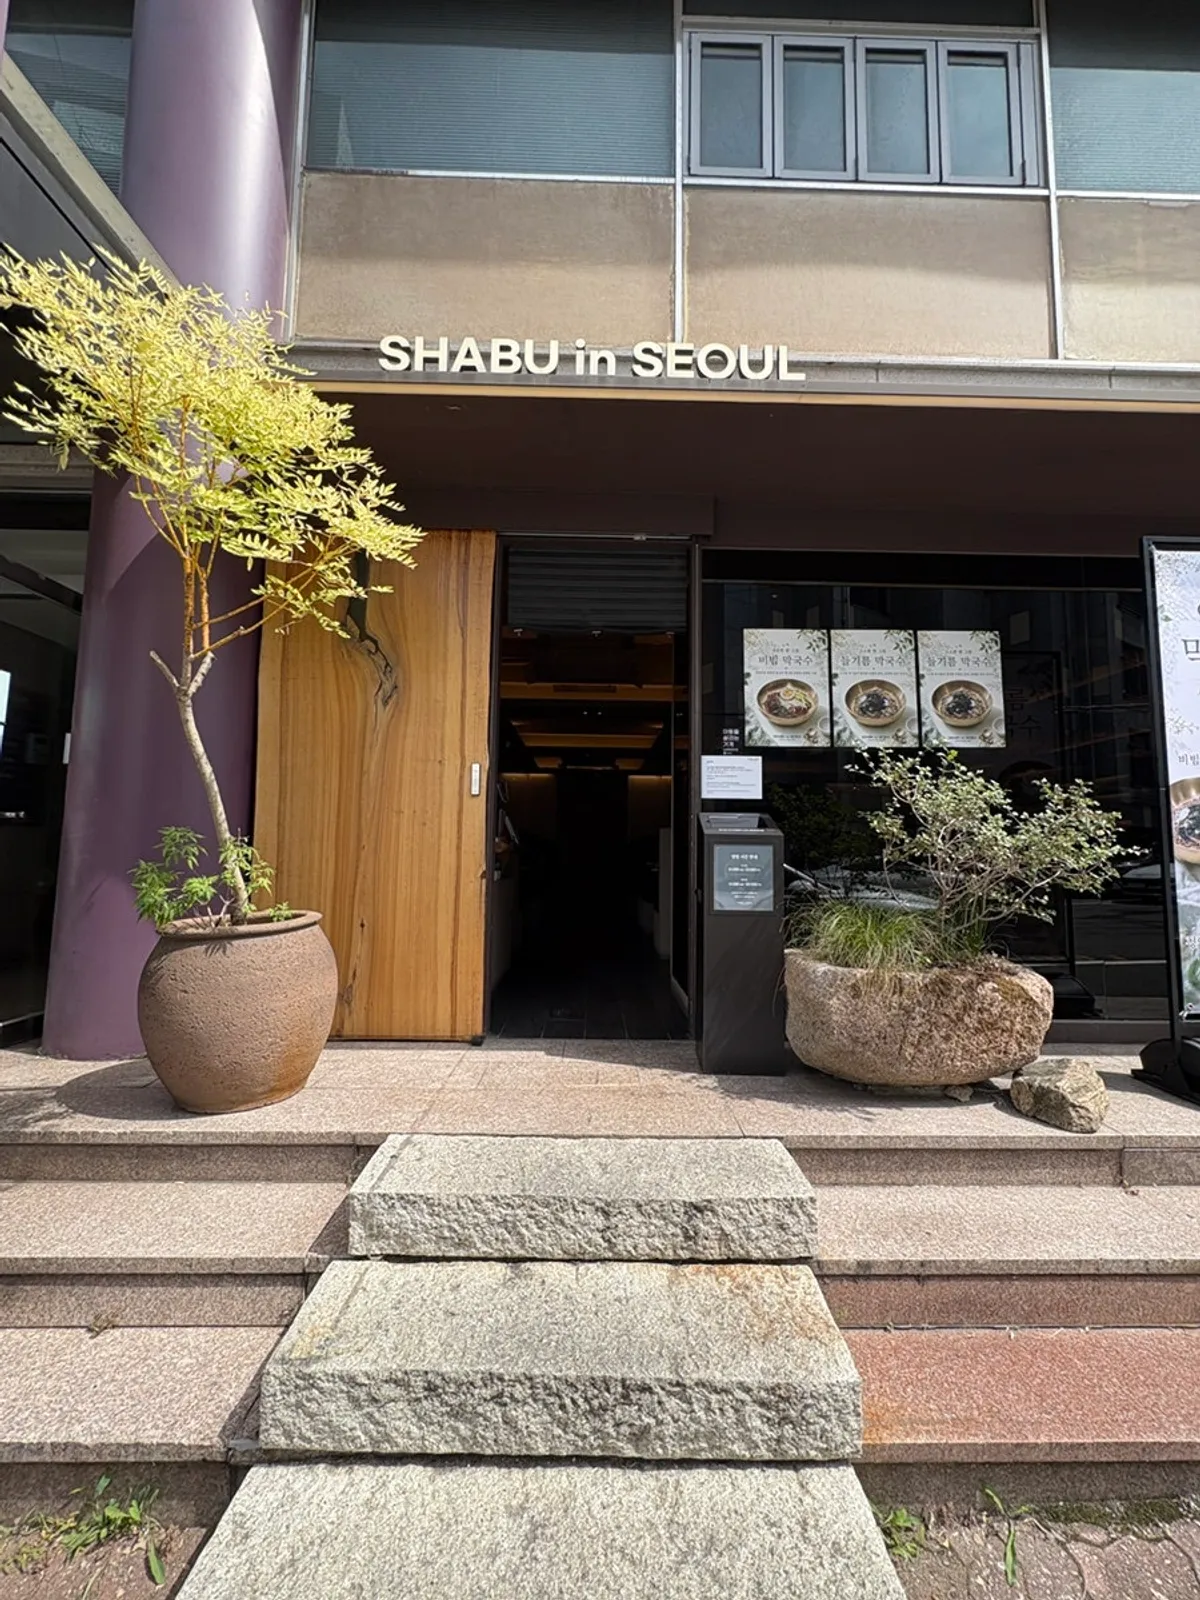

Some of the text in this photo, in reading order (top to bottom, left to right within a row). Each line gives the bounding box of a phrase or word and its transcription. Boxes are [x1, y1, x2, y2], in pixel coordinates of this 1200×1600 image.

[378, 334, 807, 382] SHABU in SEOUL
[783, 655, 812, 667] 막국수
[841, 655, 906, 667] 들기름 막국수
[927, 656, 991, 668] 들기름 막국수
